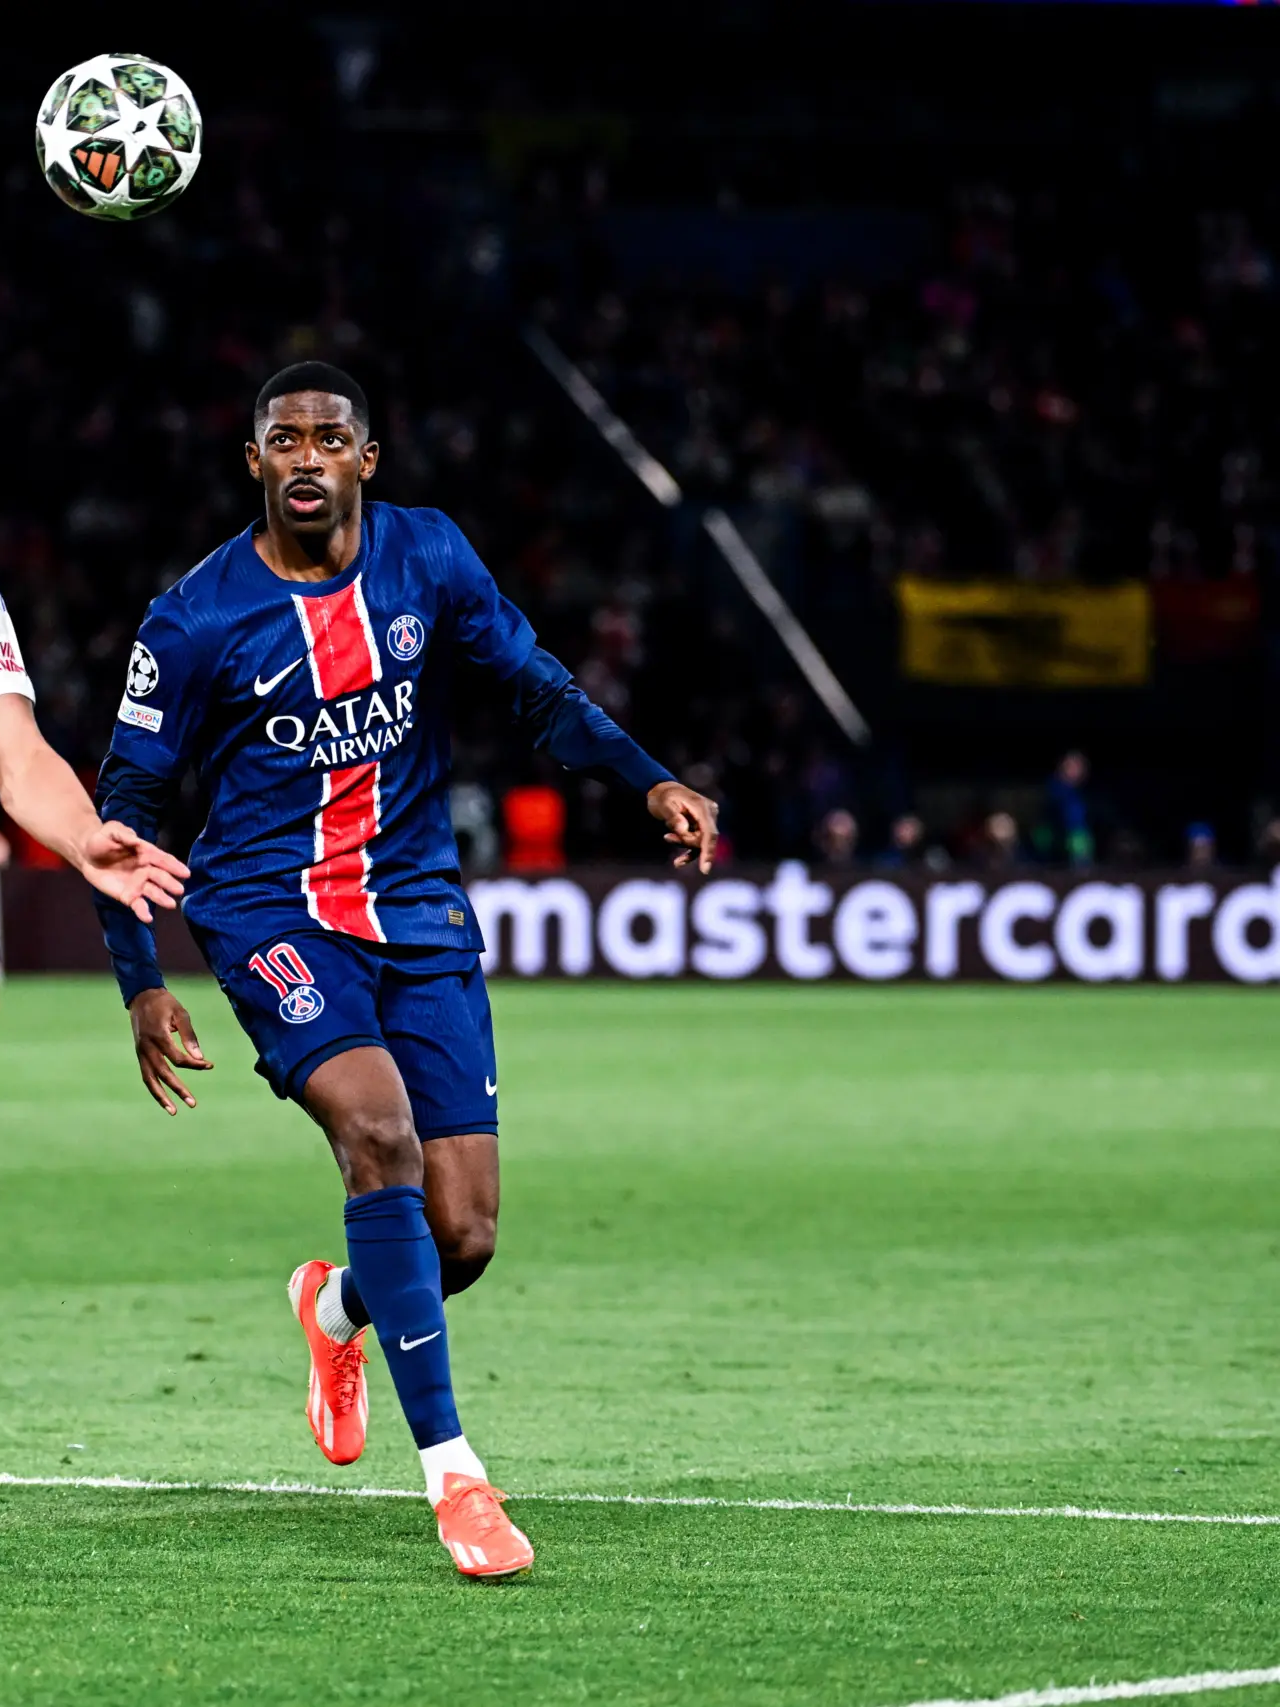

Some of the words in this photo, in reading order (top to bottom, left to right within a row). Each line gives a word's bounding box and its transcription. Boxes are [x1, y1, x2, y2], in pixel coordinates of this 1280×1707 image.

[391, 616, 416, 632] PARIS
[265, 680, 413, 752] QATAR
[468, 858, 1280, 983] mastercard
[248, 942, 315, 1000] 10
